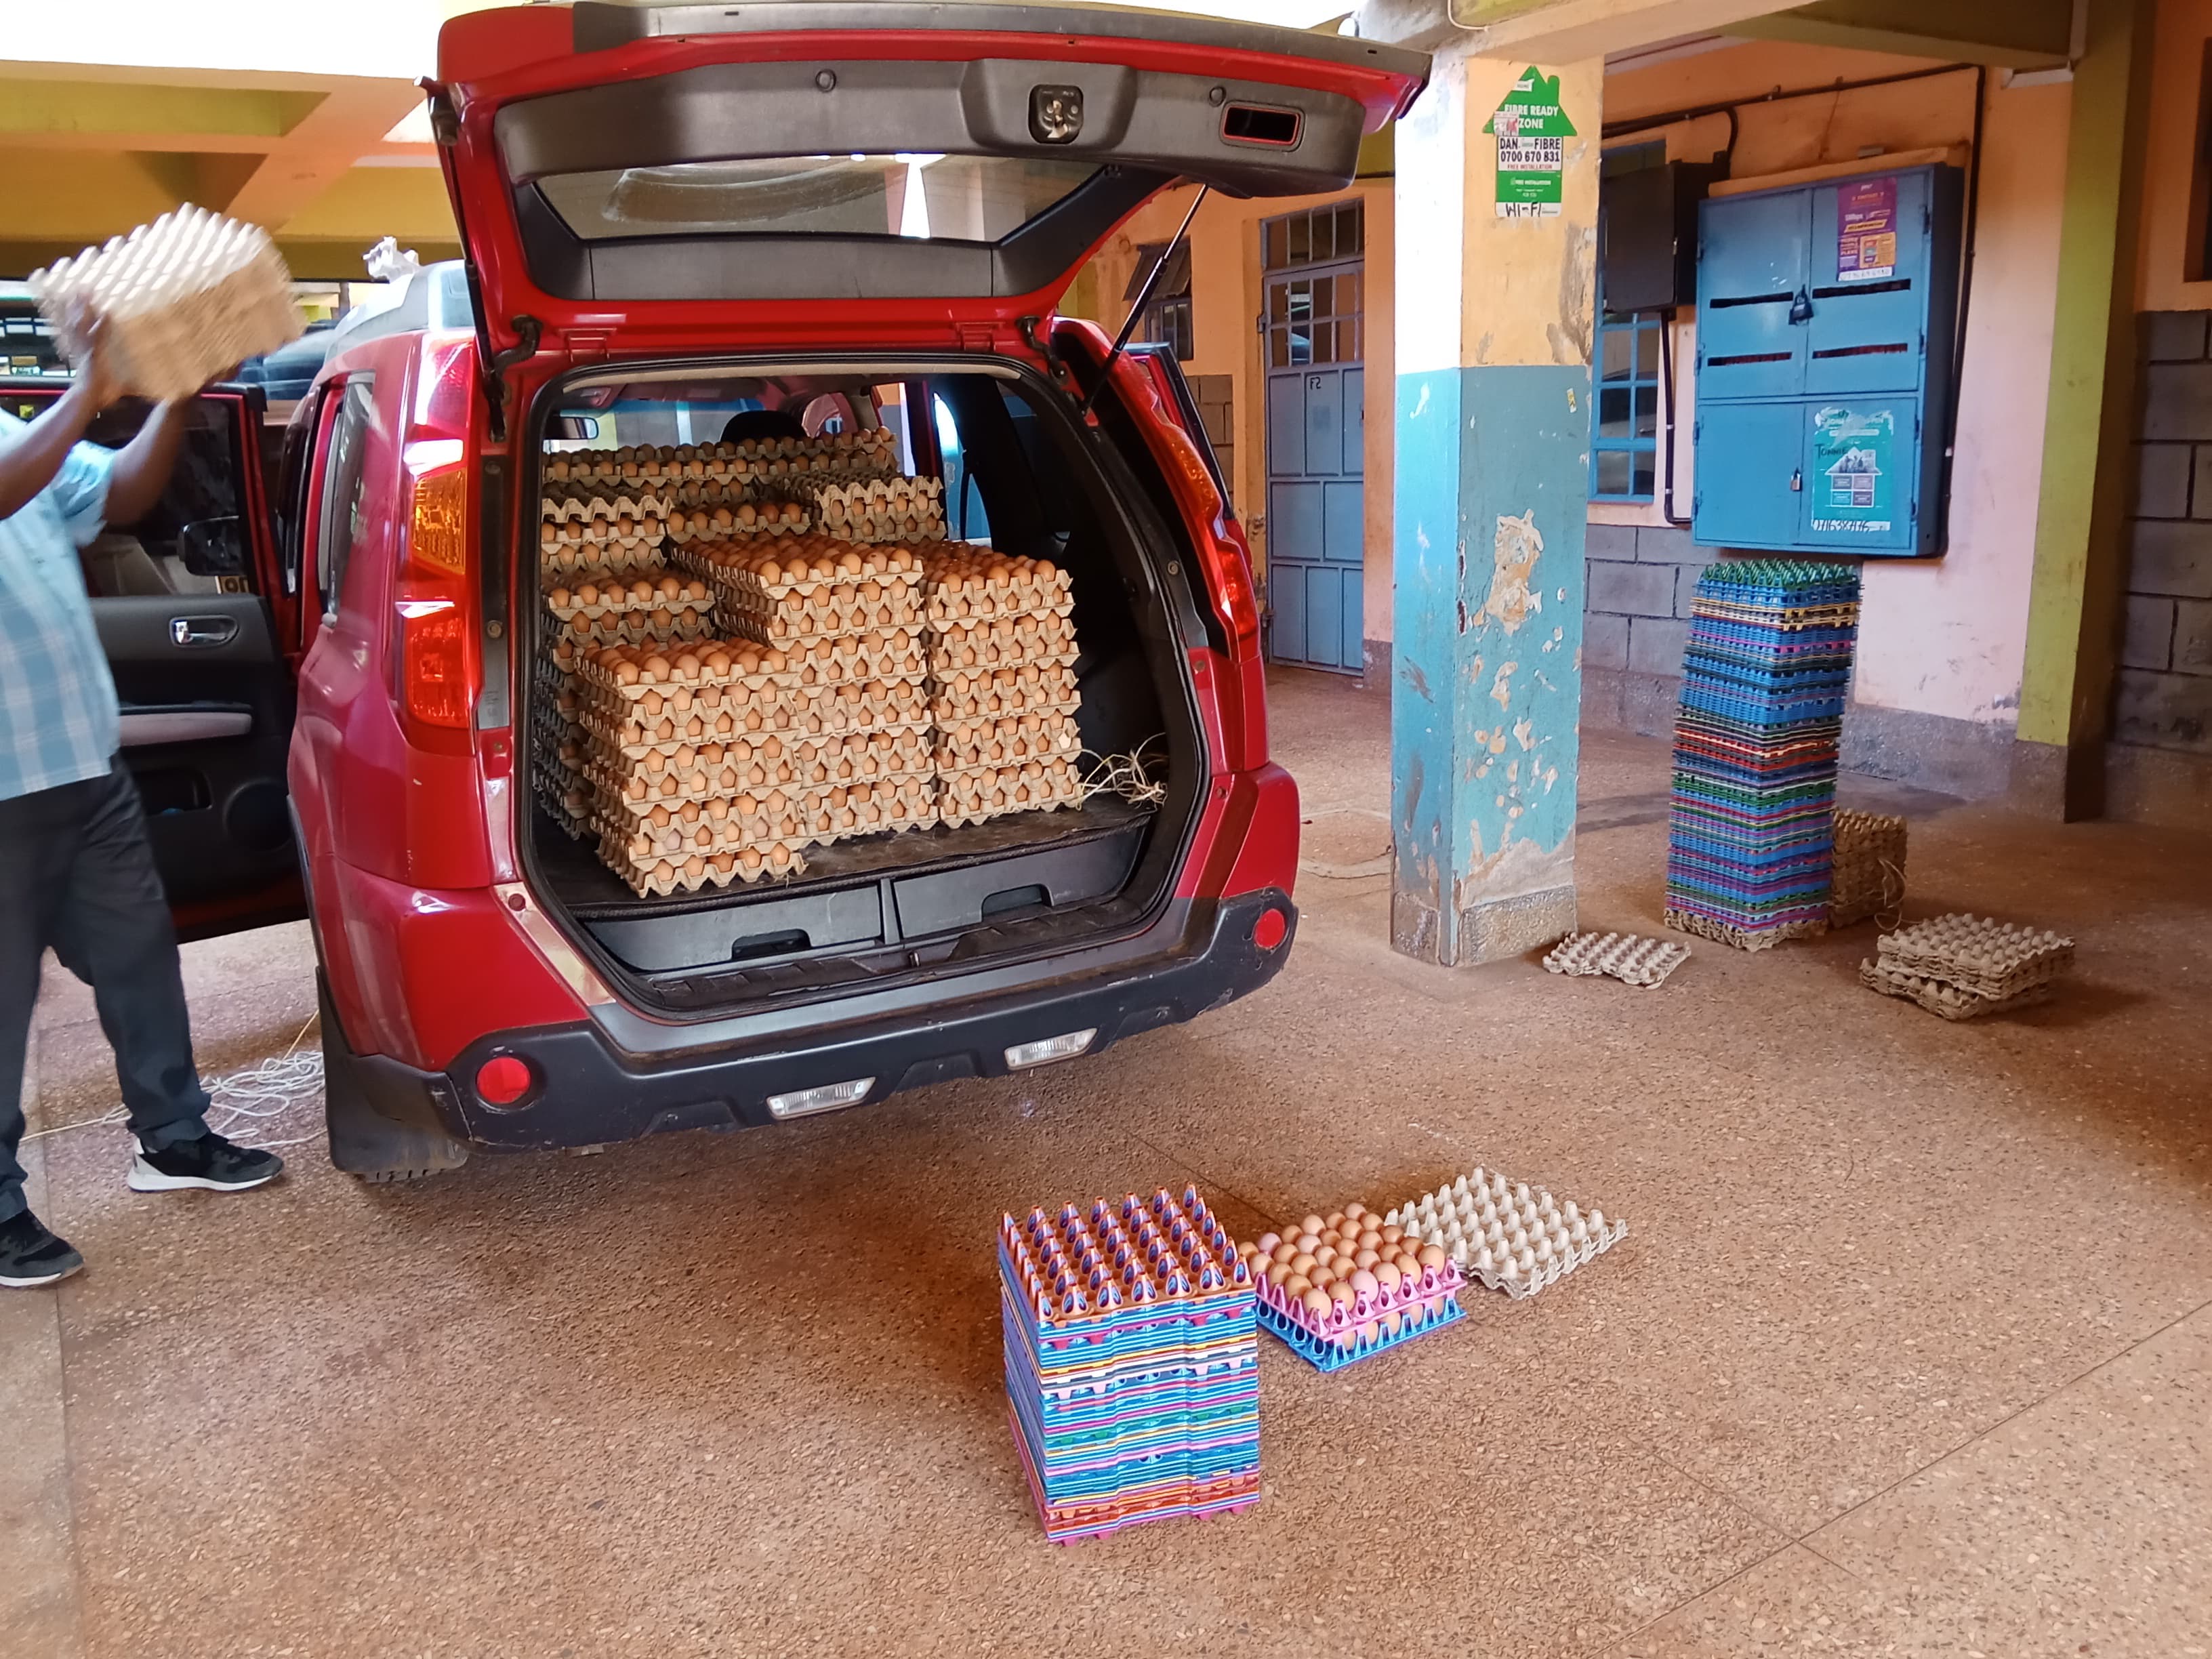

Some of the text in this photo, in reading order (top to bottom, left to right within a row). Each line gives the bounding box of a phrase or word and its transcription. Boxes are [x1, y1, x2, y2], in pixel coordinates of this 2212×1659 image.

[1504, 104, 1559, 117] FIBRE READY
[1519, 118, 1544, 129] ZONE
[1534, 138, 1560, 150] FIBRE
[1500, 150, 1560, 162] 0700 670 831
